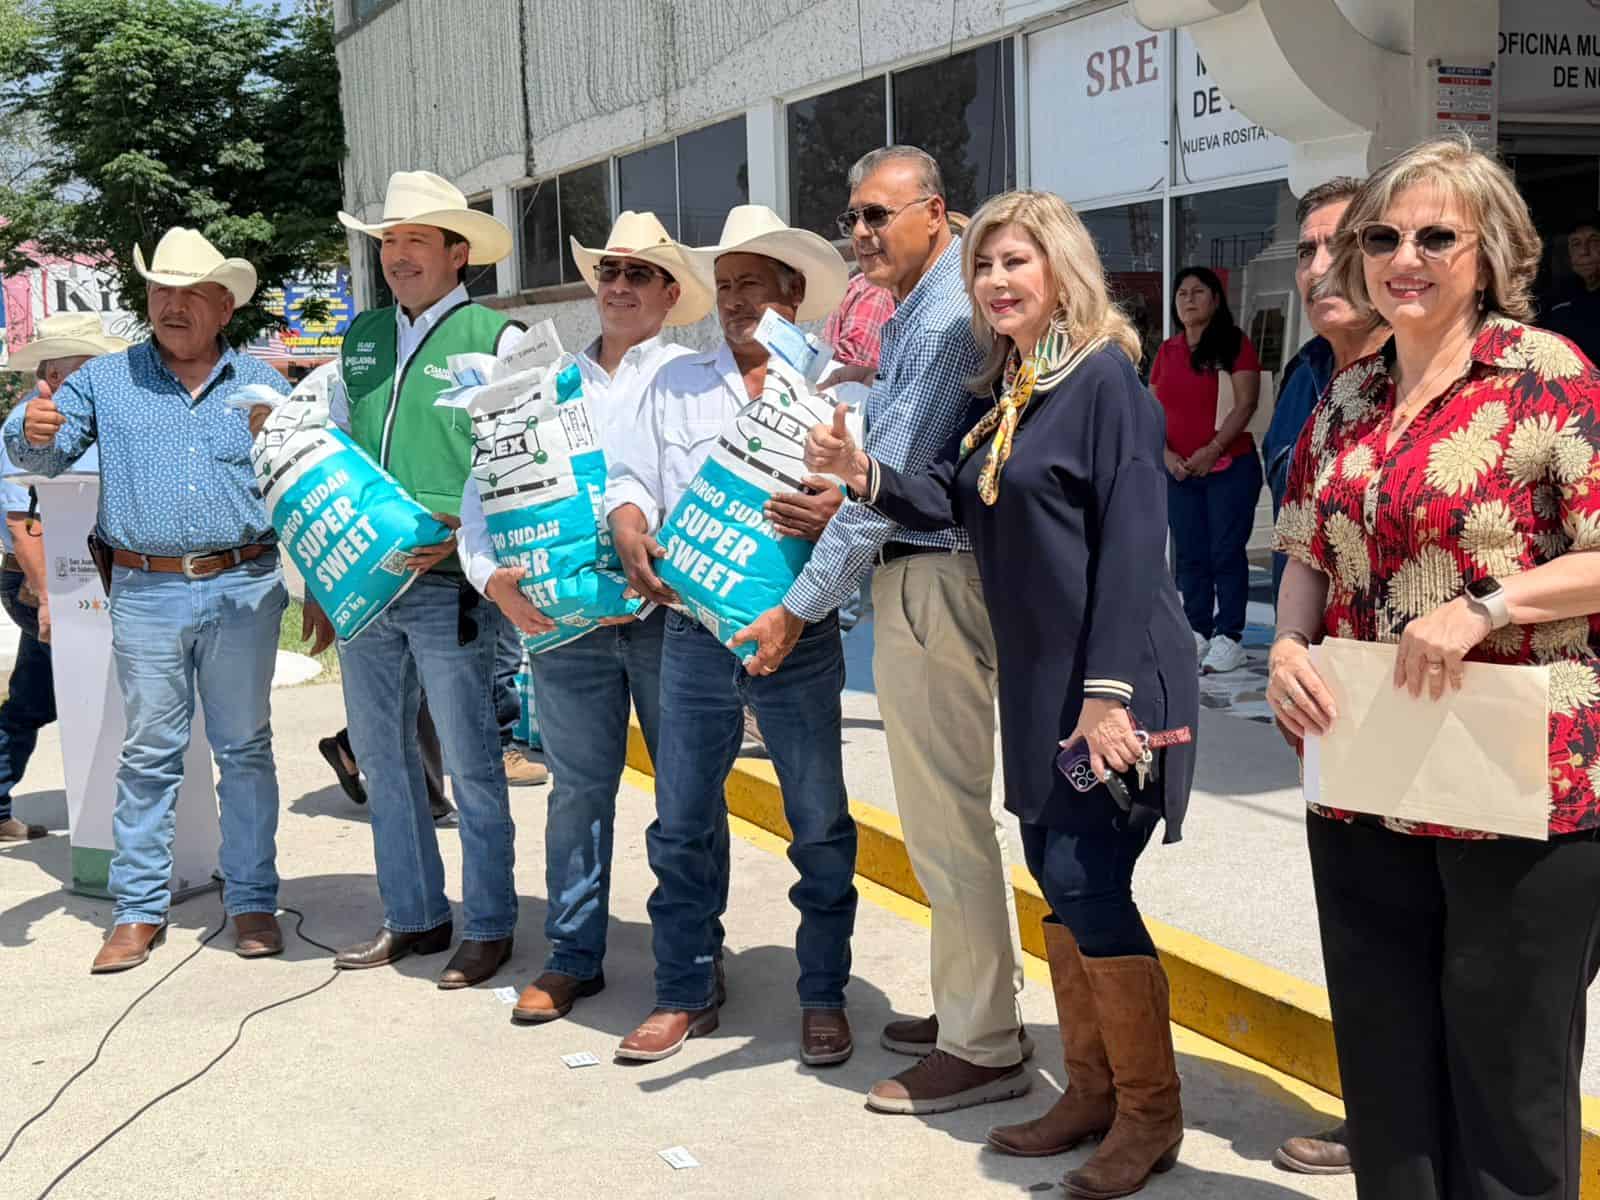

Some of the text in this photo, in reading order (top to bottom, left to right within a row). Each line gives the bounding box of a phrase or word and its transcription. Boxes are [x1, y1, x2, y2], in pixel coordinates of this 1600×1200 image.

[1086, 35, 1158, 97] SRE
[1553, 66, 1600, 89] DE N
[1193, 86, 1221, 118] DE
[1183, 126, 1269, 154] NUEVA ROSITA,
[301, 469, 349, 515] SUDAN
[296, 496, 358, 568] SUPER
[508, 519, 560, 547] SUDAN
[676, 503, 758, 568] SUPER
[316, 514, 379, 592] SWEET
[499, 548, 550, 578] PER
[663, 534, 744, 598] SWEET
[521, 578, 560, 608] EET
